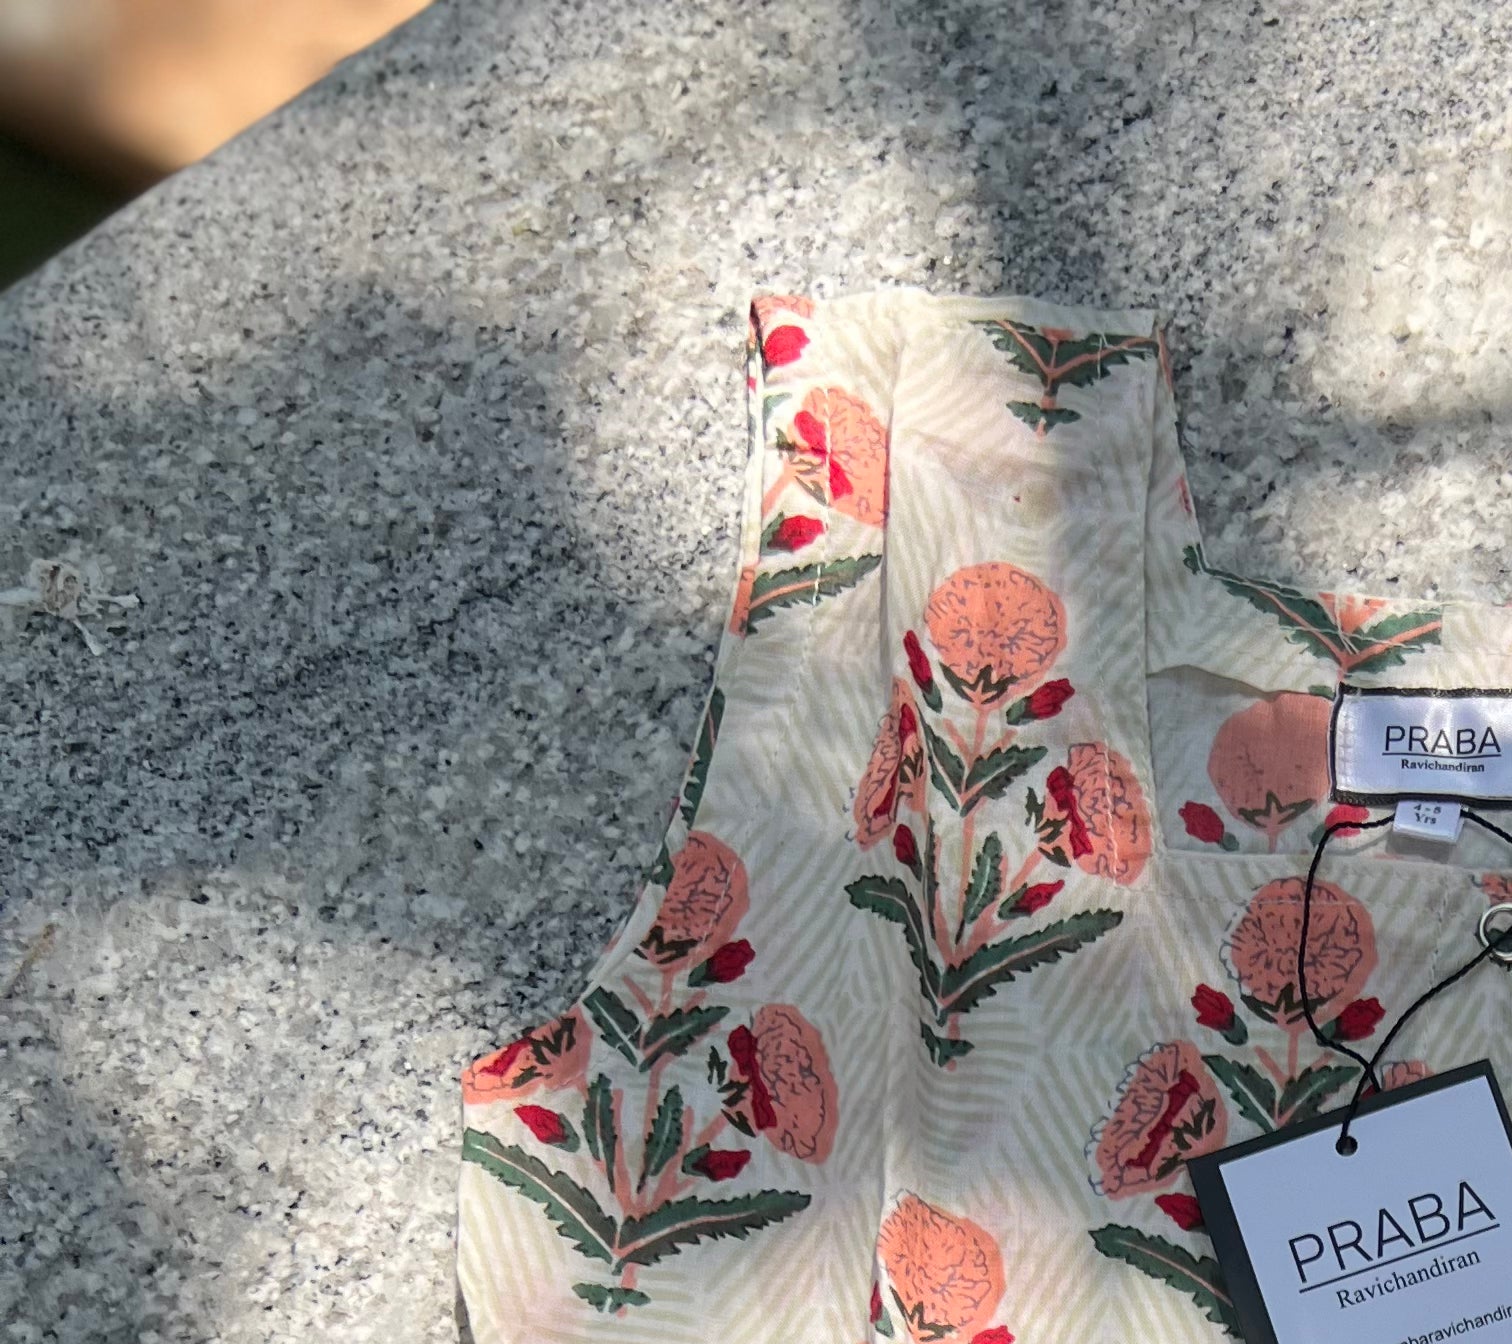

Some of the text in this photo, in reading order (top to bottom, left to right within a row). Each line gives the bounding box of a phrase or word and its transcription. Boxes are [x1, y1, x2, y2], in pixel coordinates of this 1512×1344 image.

[1385, 726, 1501, 754] PRABA
[1401, 758, 1485, 773] Ravichandiran
[1288, 1181, 1497, 1283] PRABA
[1336, 1251, 1481, 1309] Ravichandiran
